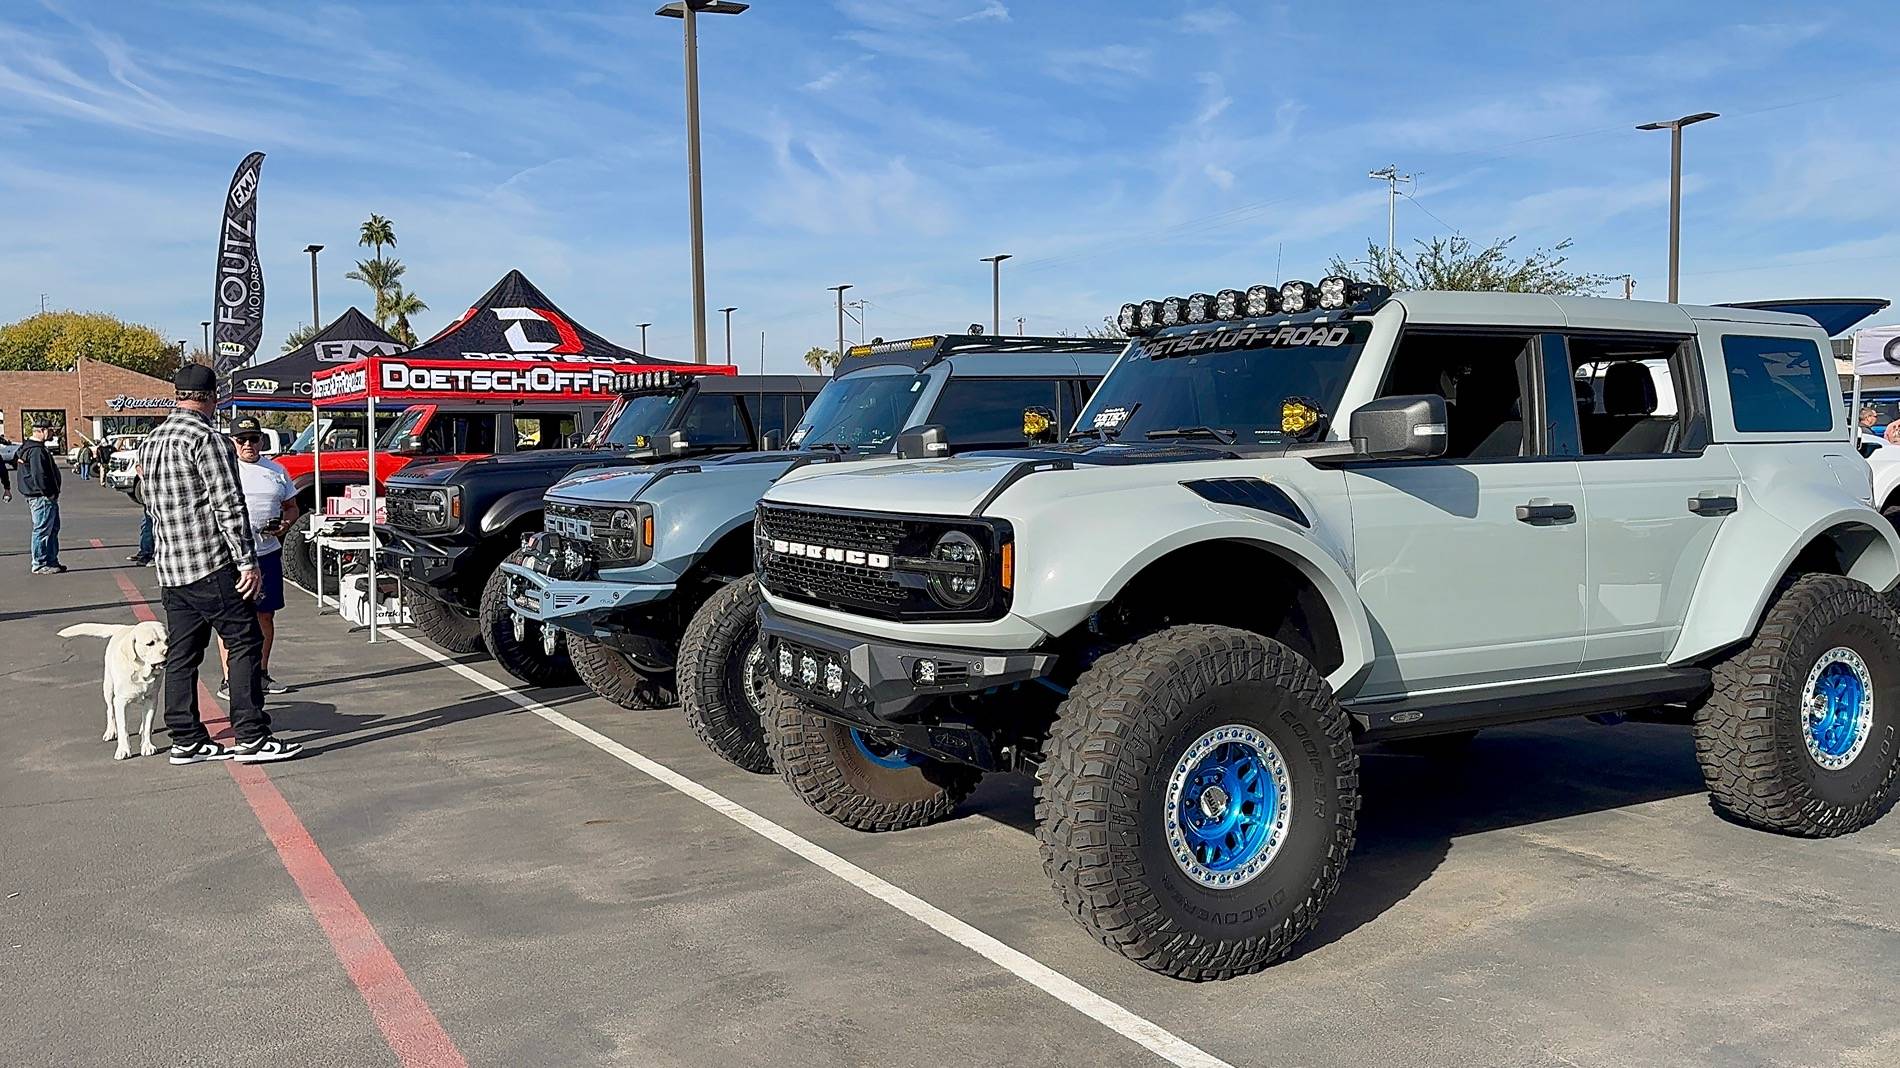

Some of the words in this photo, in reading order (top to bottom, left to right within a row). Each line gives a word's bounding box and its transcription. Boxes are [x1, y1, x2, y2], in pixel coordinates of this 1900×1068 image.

[233, 171, 257, 205] FMI
[219, 216, 252, 325] FOUTZ
[461, 351, 638, 365] DOETSCH
[1128, 330, 1220, 362] DOETSCH
[1219, 327, 1350, 348] OFF-ROAD
[249, 380, 274, 391] FMI
[544, 513, 593, 541] FORD
[774, 539, 890, 569] BRONCO
[1280, 709, 1325, 818] COOPER
